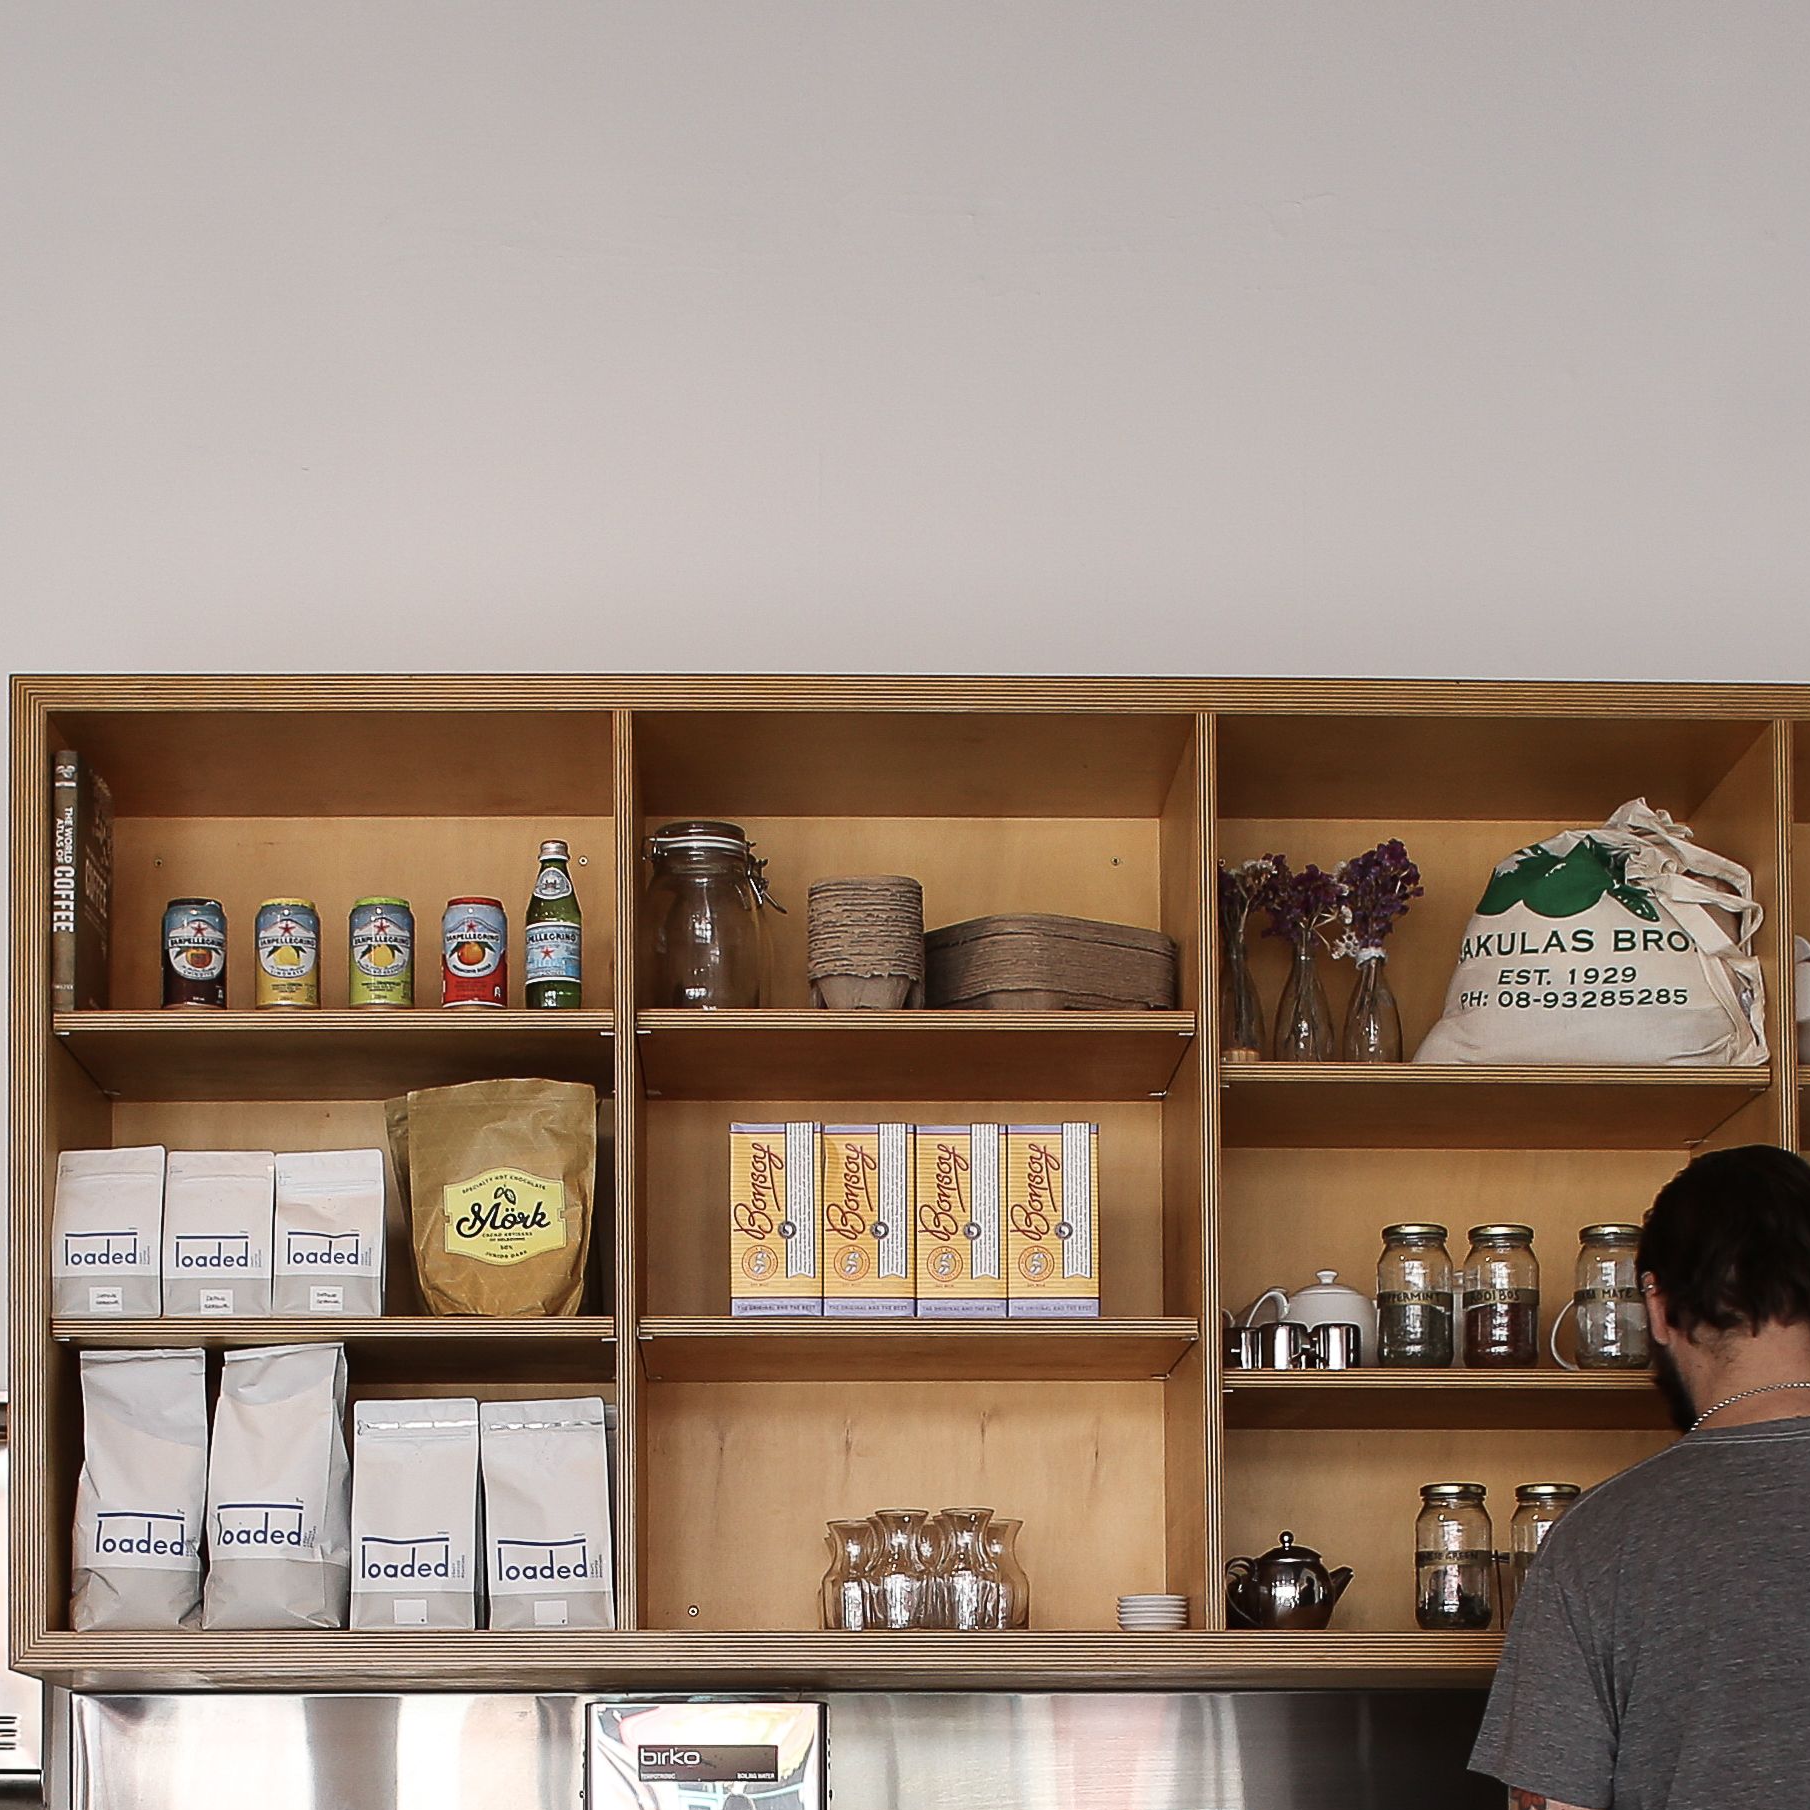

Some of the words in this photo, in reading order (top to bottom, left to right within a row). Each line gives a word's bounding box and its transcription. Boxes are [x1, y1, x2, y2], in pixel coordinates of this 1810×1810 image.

[64, 806, 74, 826] THE
[56, 818, 64, 848] ATLAS
[64, 827, 74, 863] WORLD
[56, 849, 64, 863] OF
[53, 865, 75, 933] COFFEE
[1459, 928, 1594, 964] AKULAS
[1613, 929, 1699, 953] BRO
[1496, 968, 1552, 986] EST.
[1568, 966, 1637, 985] 1929
[1460, 990, 1489, 1010] PH:
[1496, 988, 1689, 1009] 08-93285285
[734, 1142, 785, 1241] Bonsoy
[826, 1142, 877, 1241] Bonsoy
[918, 1143, 969, 1242] Bonsoy
[1010, 1143, 1061, 1242] Bonsoy
[455, 1201, 551, 1238] Mörk
[65, 1237, 138, 1266] loaded
[175, 1240, 249, 1268] loaded
[287, 1237, 359, 1265] loaded
[1386, 1291, 1440, 1304] PPERMINT
[1470, 1289, 1520, 1304] ROOIBOS
[96, 1519, 184, 1556] loaded
[217, 1511, 302, 1547] loaded
[361, 1544, 449, 1579] loaded
[498, 1545, 588, 1581] loaded
[640, 1747, 701, 1765] birko
[757, 1772, 775, 1780] WATER
